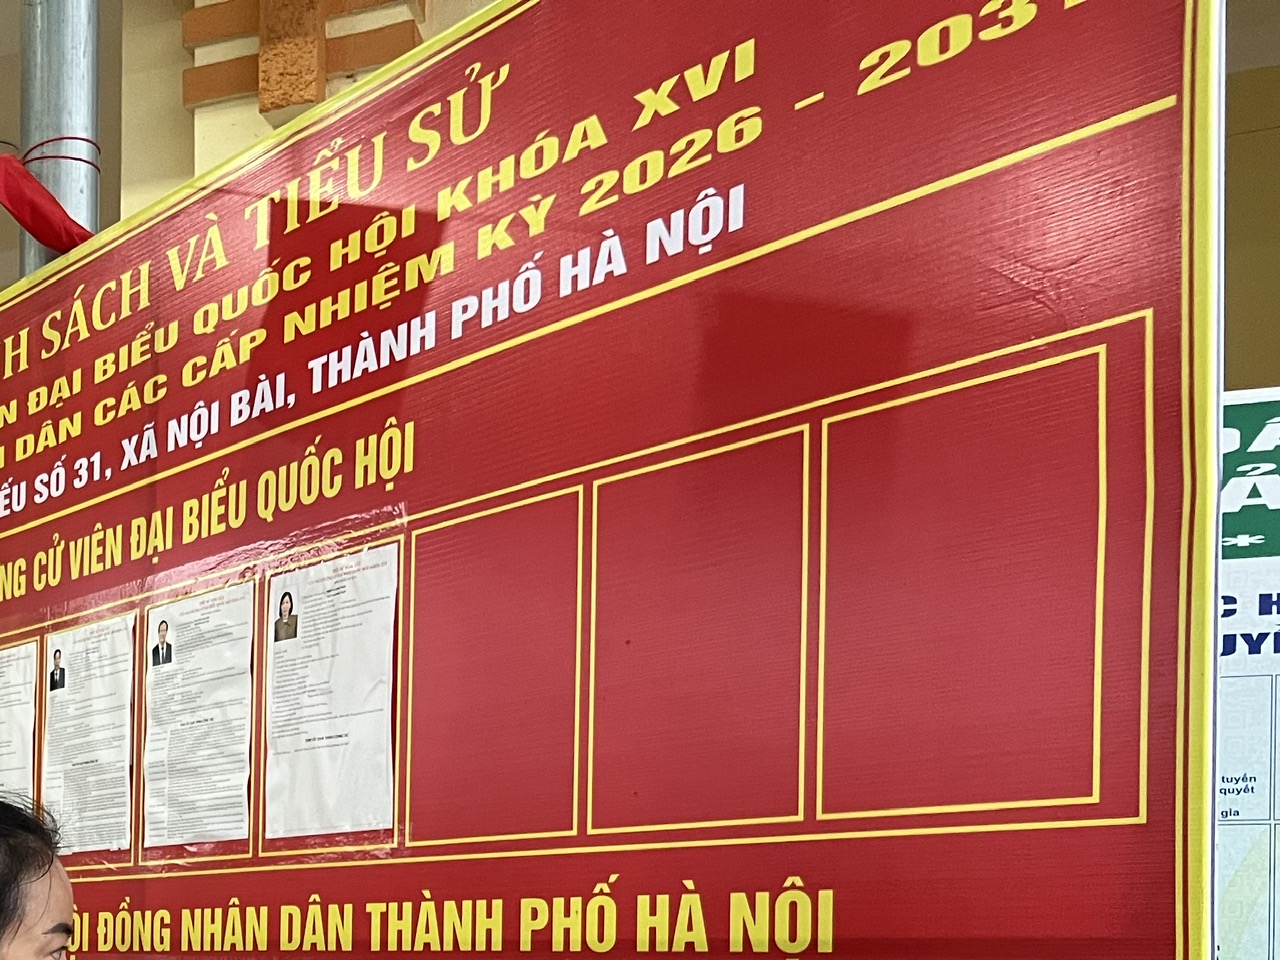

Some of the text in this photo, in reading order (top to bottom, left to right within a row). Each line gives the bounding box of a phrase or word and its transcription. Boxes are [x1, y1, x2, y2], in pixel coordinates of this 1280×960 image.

[16, 412, 83, 462] DÂN
[95, 374, 169, 427] CÁC
[182, 328, 268, 387] CẤP
[283, 239, 456, 345] NHIỆM
[476, 192, 558, 261] KỲ
[579, 106, 764, 217] 2026
[795, 92, 825, 112] -
[856, 0, 1087, 97] 203
[27, 368, 83, 417] ĐẠI
[95, 319, 180, 386] BIỂU
[194, 250, 313, 336] QUỐC
[330, 200, 420, 273] HỘI
[436, 115, 609, 222] KHÓA
[632, 38, 756, 131] XVI
[33, 455, 66, 505] SỐ
[73, 451, 113, 488] 31,
[120, 418, 159, 472] XÃ
[167, 400, 220, 453] NỘI
[230, 372, 297, 428] BÀI,
[307, 308, 438, 394] THÀNH
[451, 250, 543, 341] PHỐ
[559, 228, 629, 298] HÀ
[645, 183, 746, 266] NỘI
[41, 259, 153, 361] SÁCH
[166, 209, 230, 292] VÀ
[245, 131, 387, 252] TIỂU
[406, 62, 510, 173] SỬ
[33, 532, 65, 592] CỬ
[69, 521, 123, 581] VIÊN
[130, 506, 175, 565] ĐẠI
[182, 467, 248, 538] BIỂU
[257, 434, 343, 519] QUỐC
[354, 416, 416, 490] HỘI
[67, 903, 90, 960] ỘI
[97, 896, 171, 952] ĐỒNG
[181, 897, 268, 952] NHÂN
[280, 893, 354, 952] DÂN
[365, 888, 503, 953] THÀNH
[520, 874, 618, 953] PHỐ
[636, 879, 710, 953] HÀ
[1221, 808, 1240, 819] gia
